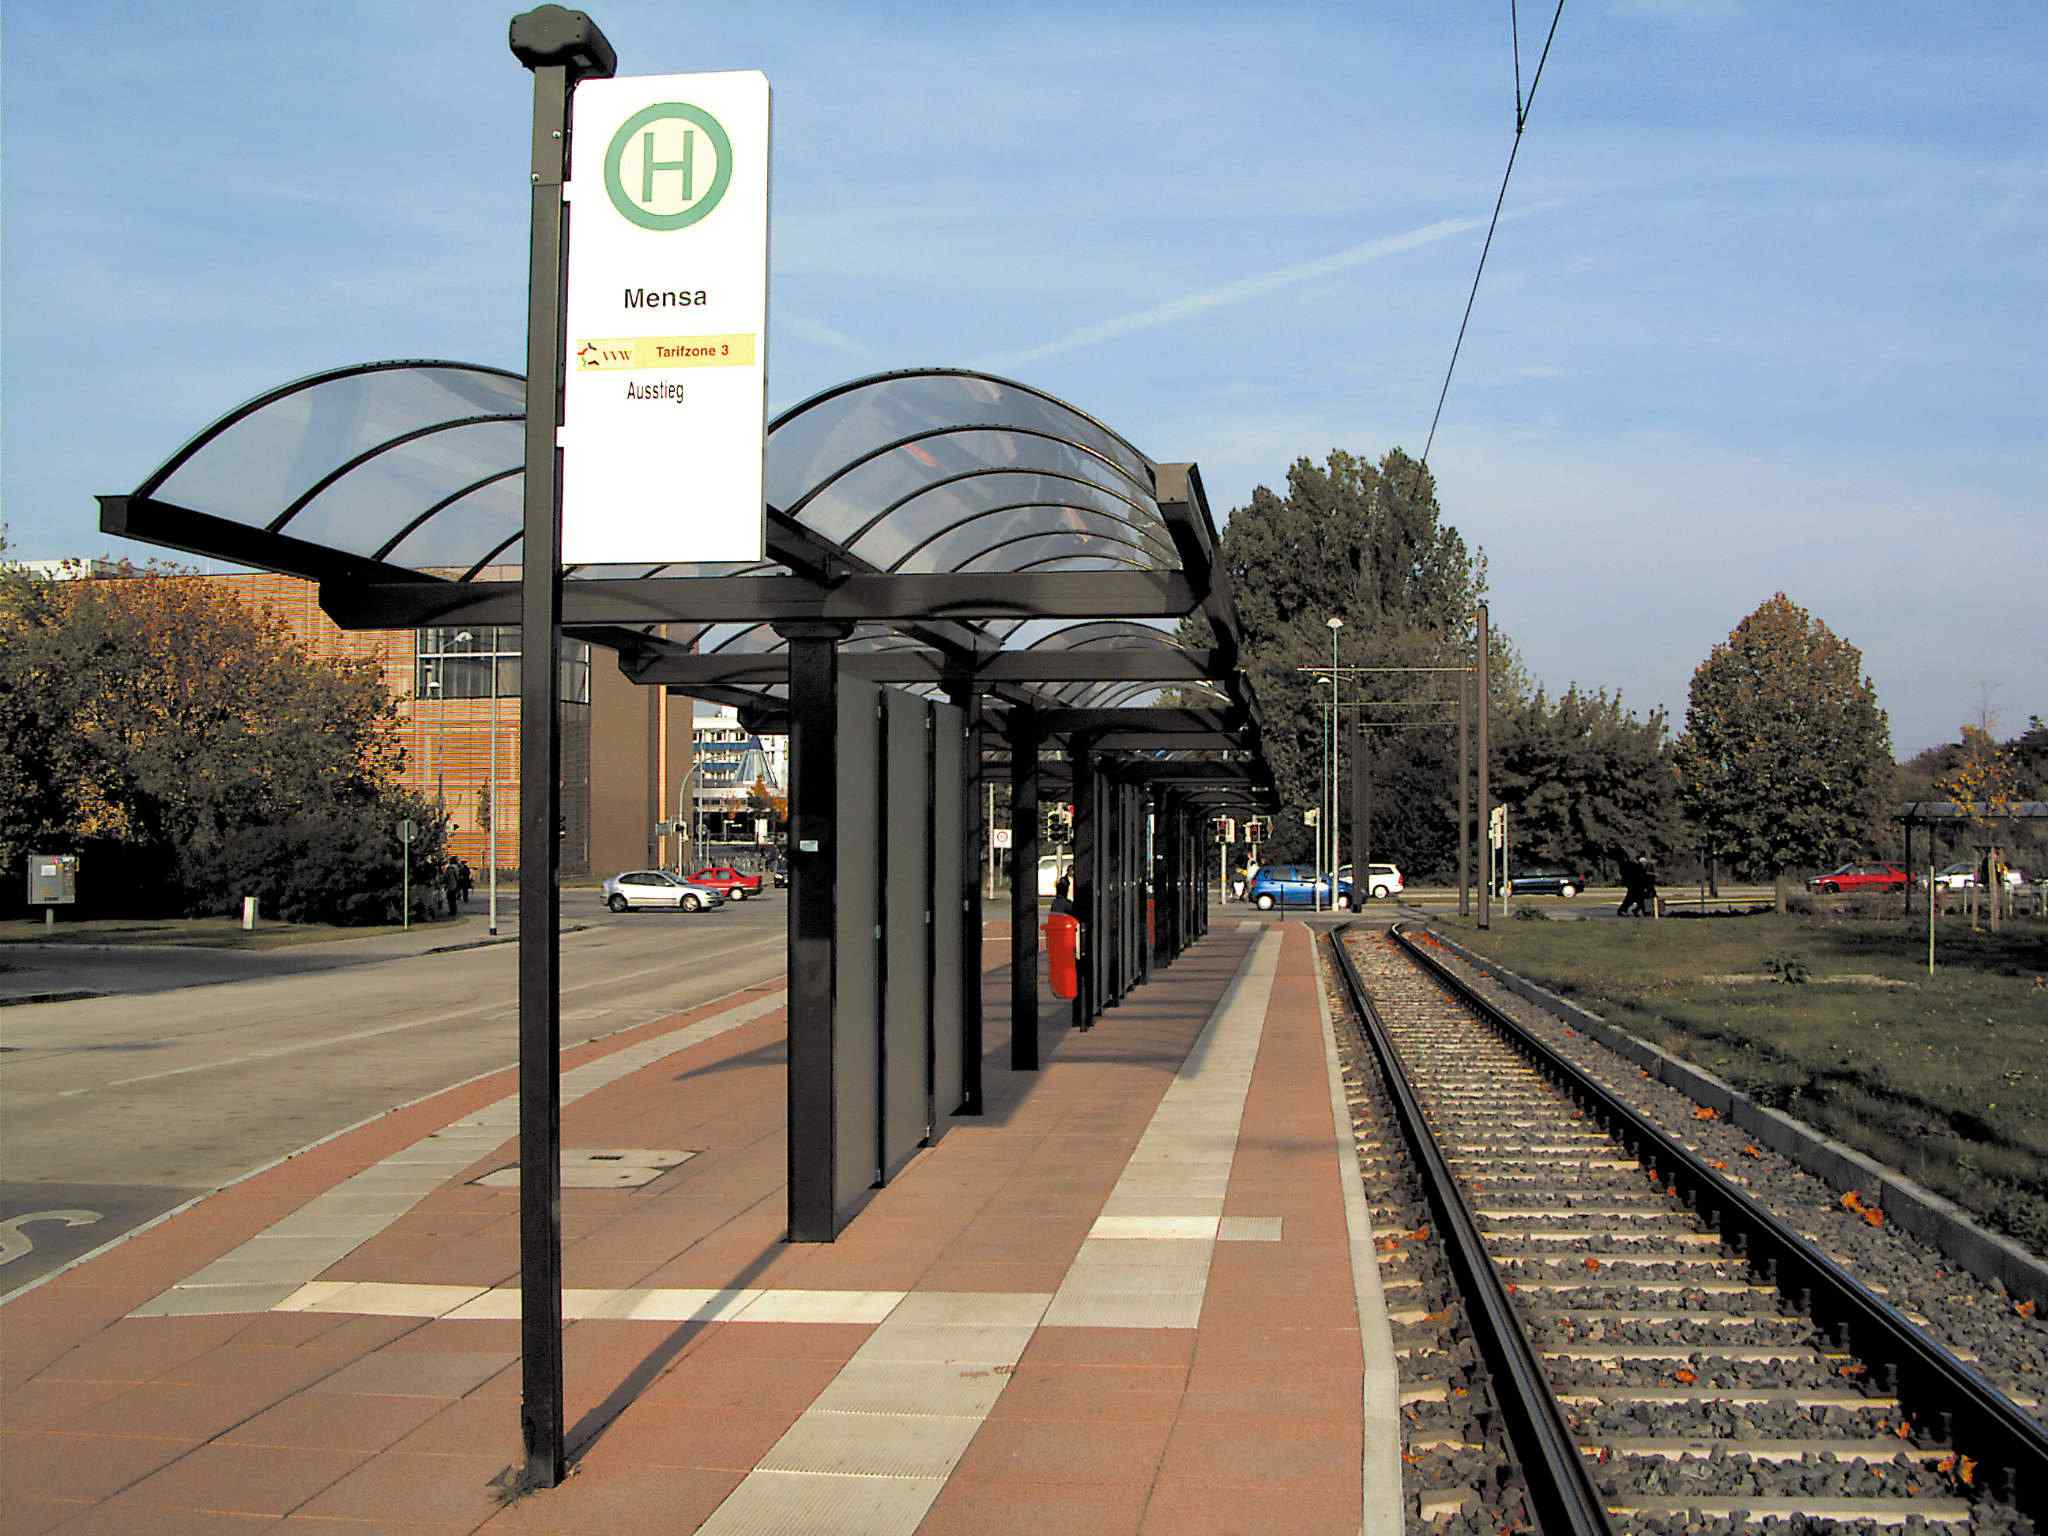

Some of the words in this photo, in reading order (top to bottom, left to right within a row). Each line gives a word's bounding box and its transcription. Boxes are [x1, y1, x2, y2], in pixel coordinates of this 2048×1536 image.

[642, 130, 694, 202] H
[624, 288, 707, 309] Mensa
[656, 345, 716, 359] Tarifzone
[721, 344, 729, 356] 3
[627, 380, 684, 404] Ausstieg
